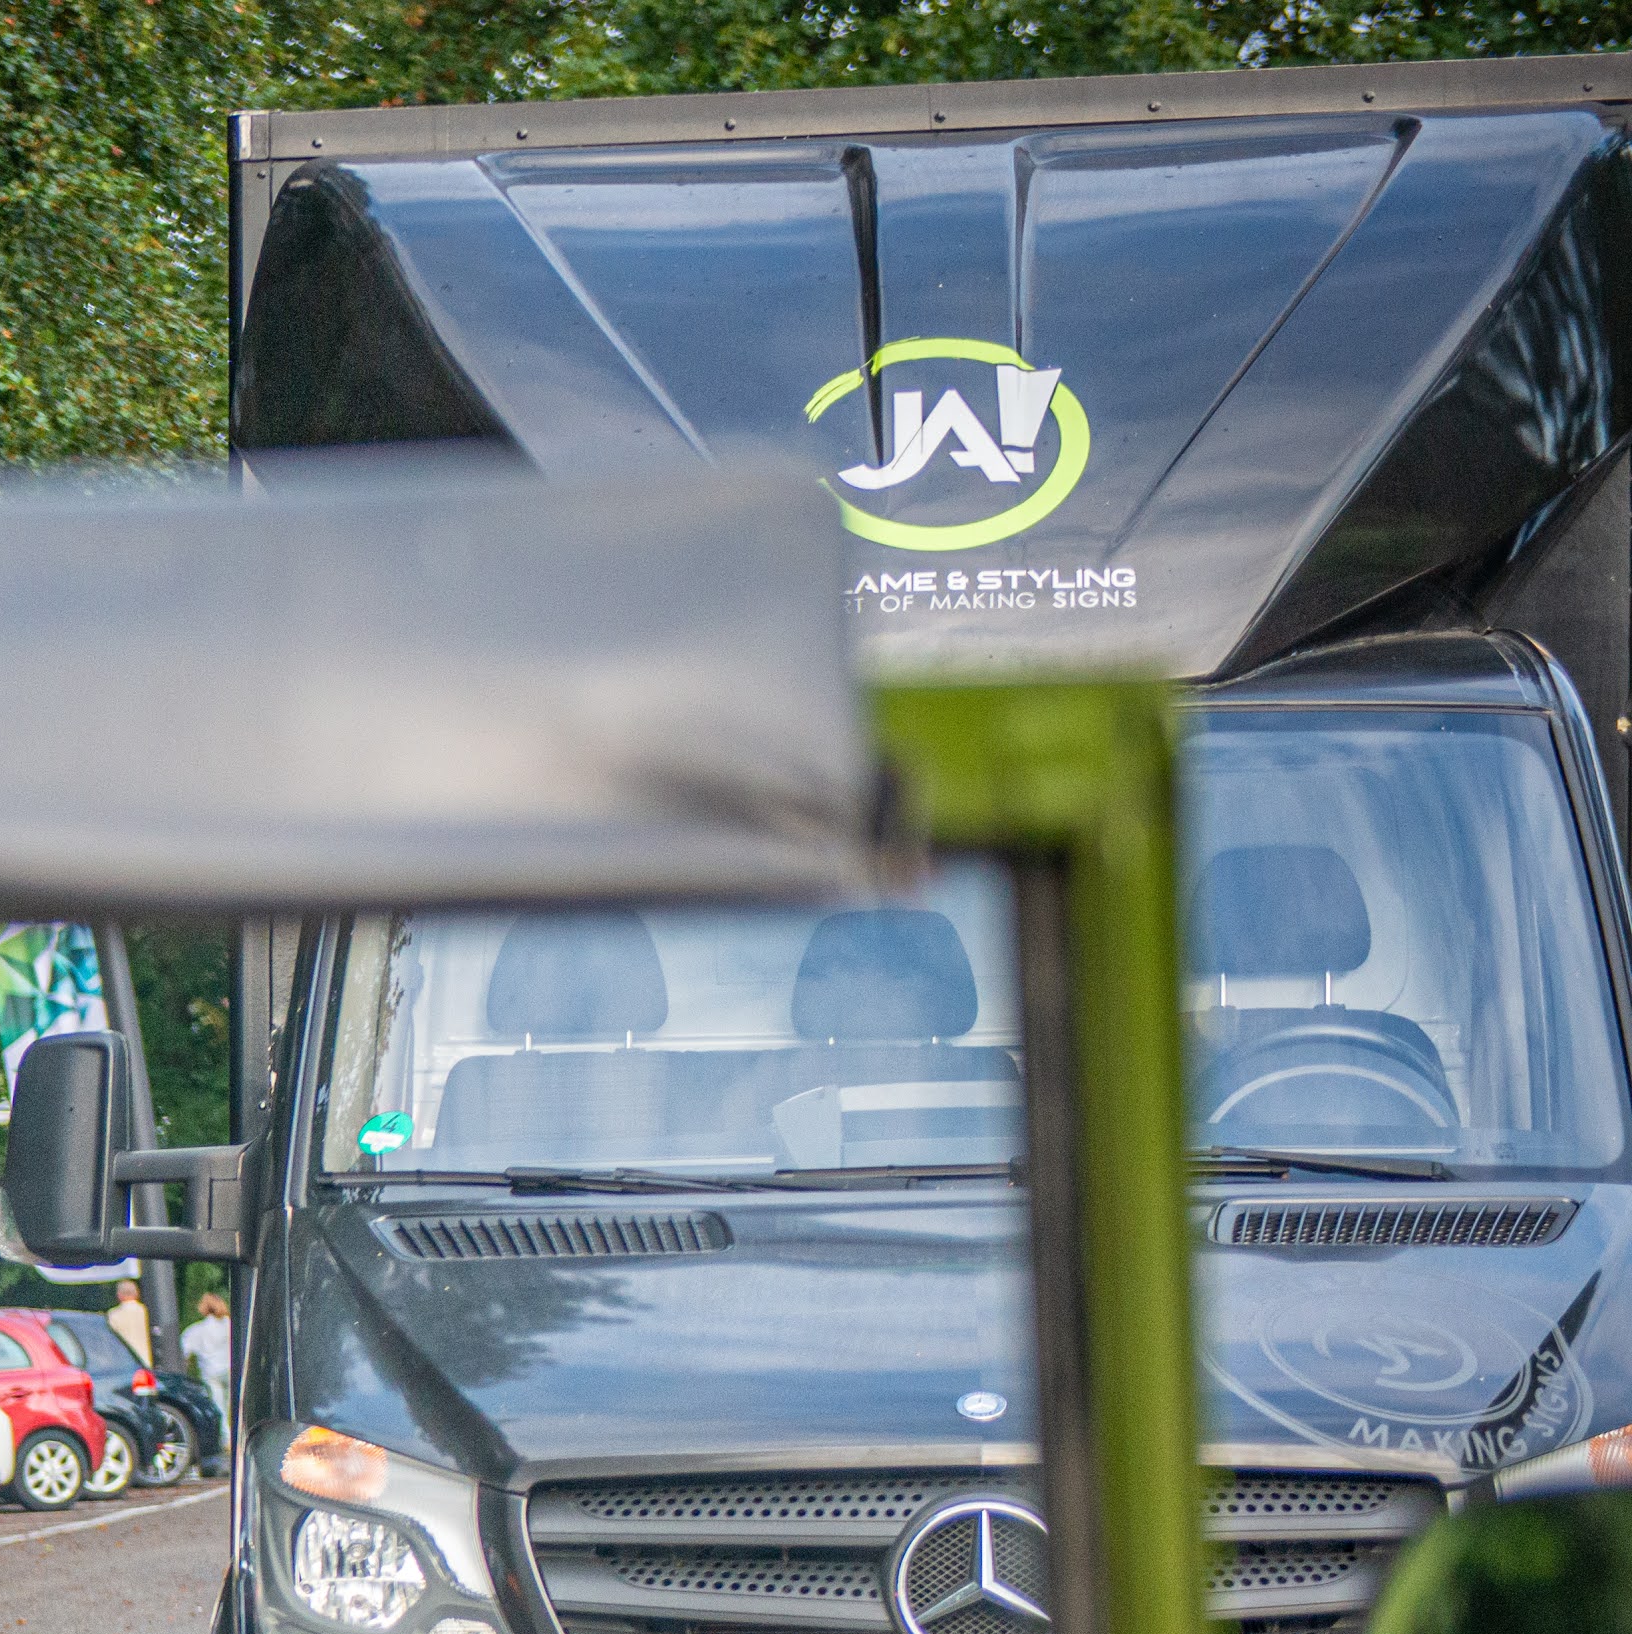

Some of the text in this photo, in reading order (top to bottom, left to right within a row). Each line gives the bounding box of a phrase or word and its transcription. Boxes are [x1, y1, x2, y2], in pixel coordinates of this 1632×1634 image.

[837, 363, 1062, 490] JA!
[880, 594, 915, 613] OF
[929, 591, 1036, 611] MAKING
[1052, 589, 1137, 609] SIGNS
[946, 570, 969, 591] &
[976, 567, 1137, 591] STYLING
[1348, 1349, 1569, 1465] MAKING SIGNS
